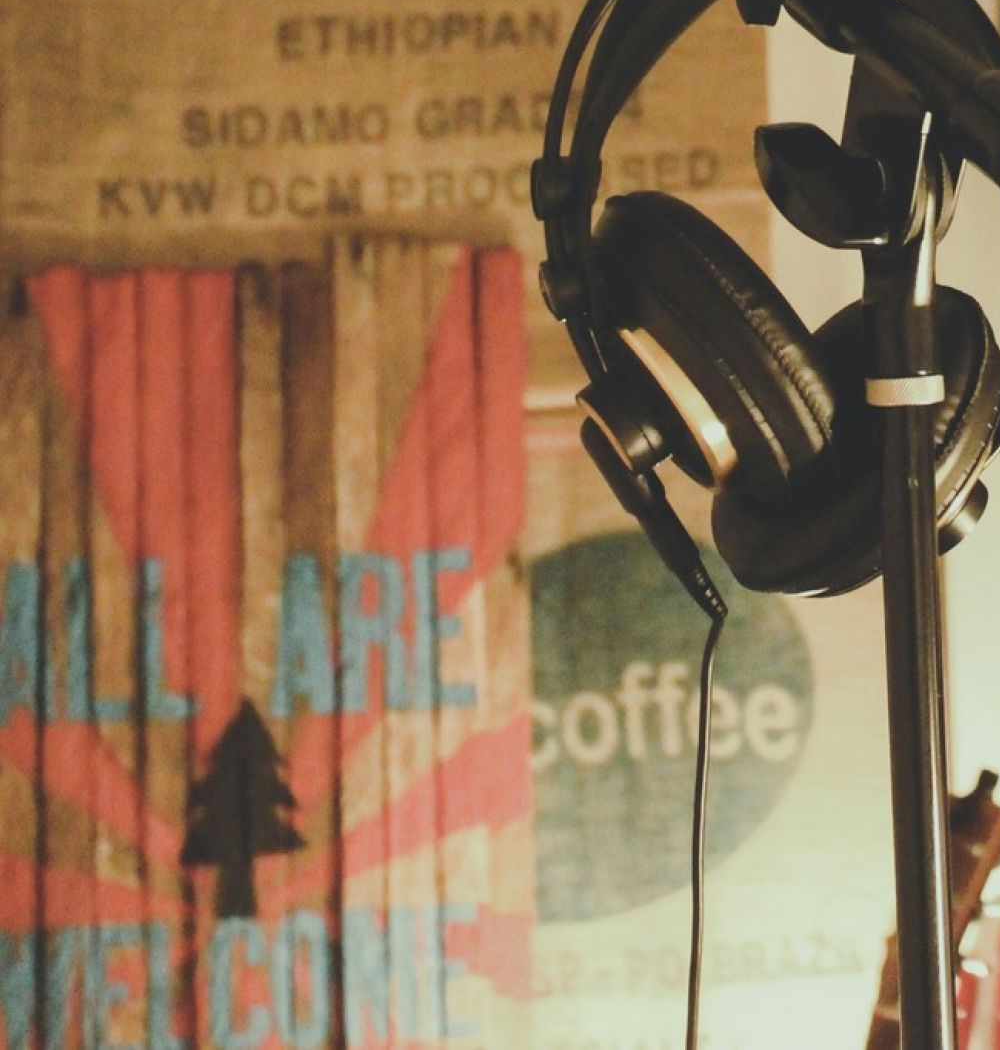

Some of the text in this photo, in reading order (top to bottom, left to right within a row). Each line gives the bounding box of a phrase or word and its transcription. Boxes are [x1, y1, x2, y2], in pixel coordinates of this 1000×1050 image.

[276, 8, 563, 62] ETHIOPIAN
[182, 102, 391, 150] SIDAMO
[98, 176, 220, 219] KVW
[385, 146, 722, 212] PROCSED
[271, 544, 478, 720] ARE
[528, 658, 802, 772] coffee
